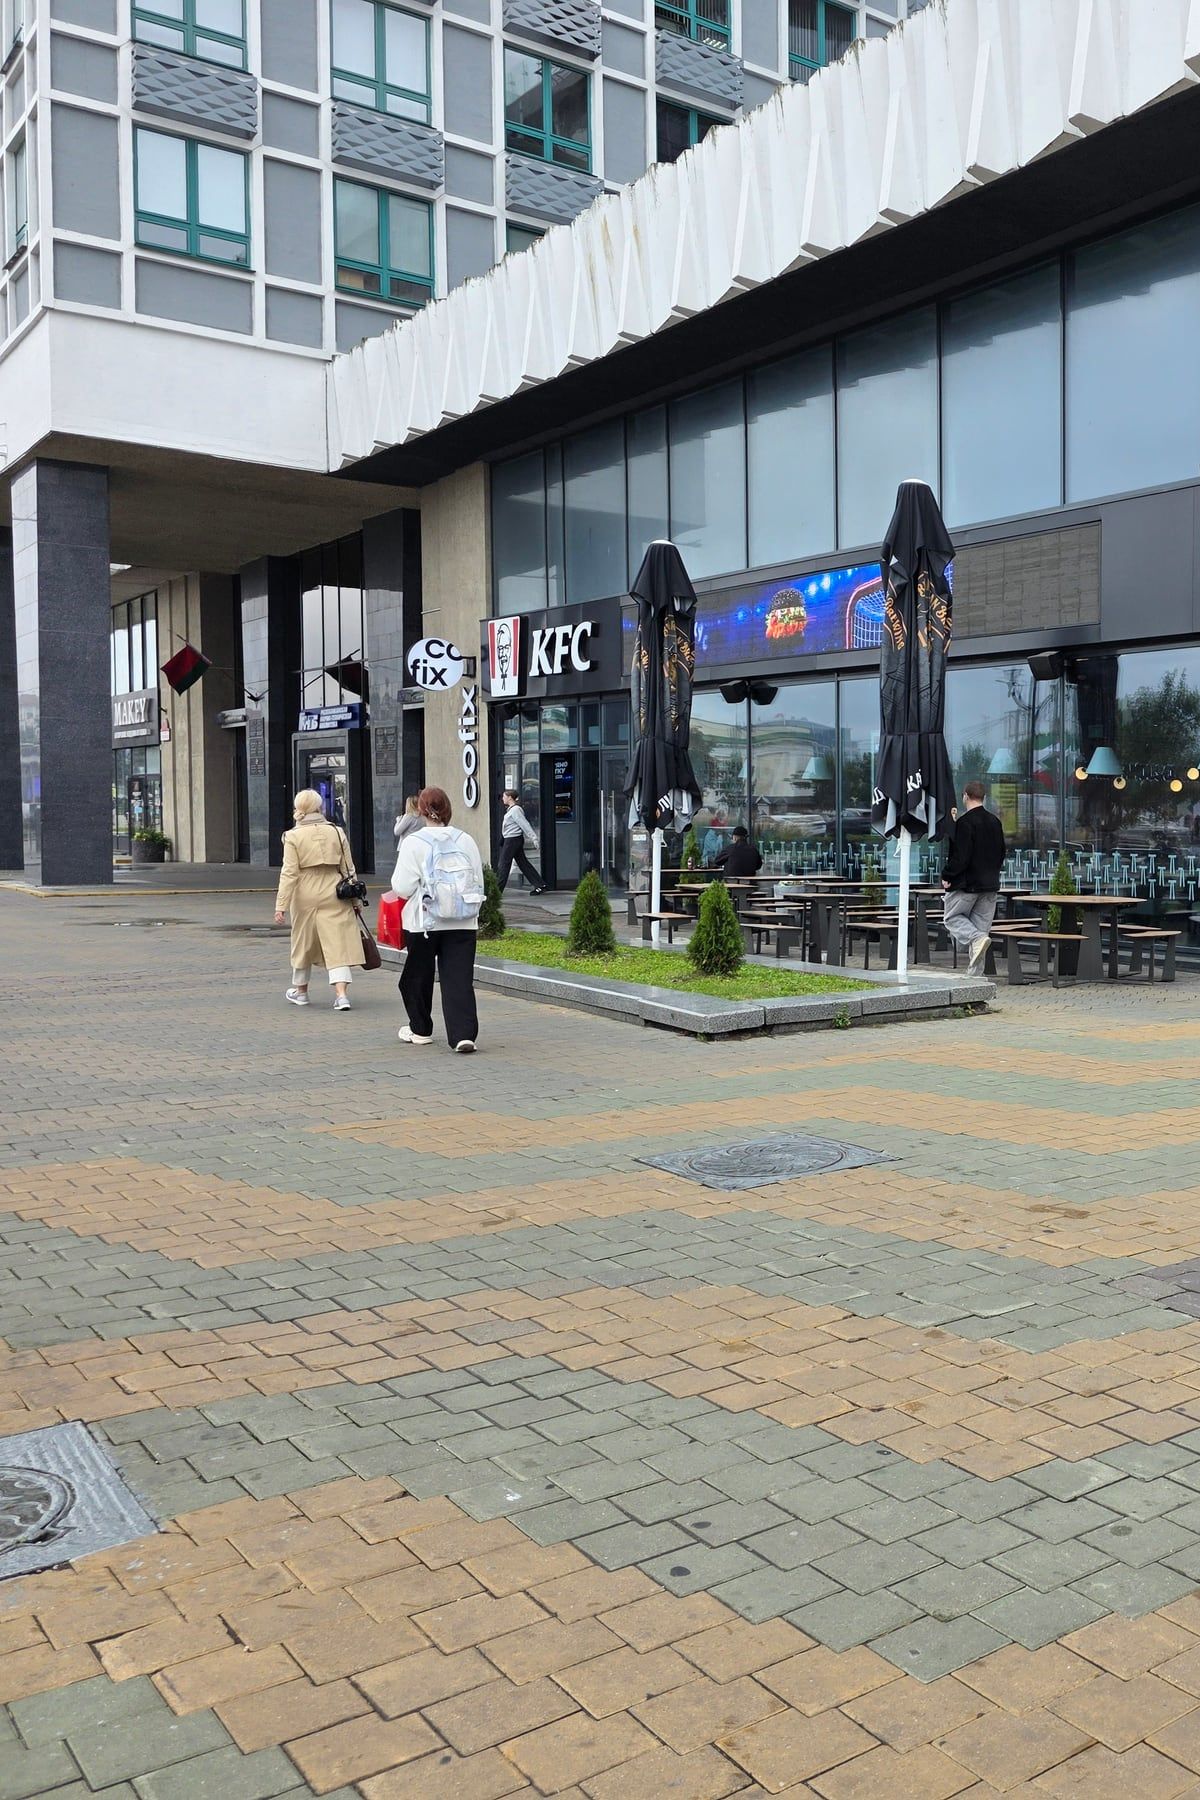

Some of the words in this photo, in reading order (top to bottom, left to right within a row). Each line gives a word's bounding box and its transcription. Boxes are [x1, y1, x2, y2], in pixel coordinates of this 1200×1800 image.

[529, 621, 592, 677] KFC
[410, 658, 448, 687] fix
[113, 698, 147, 726] MAKEY
